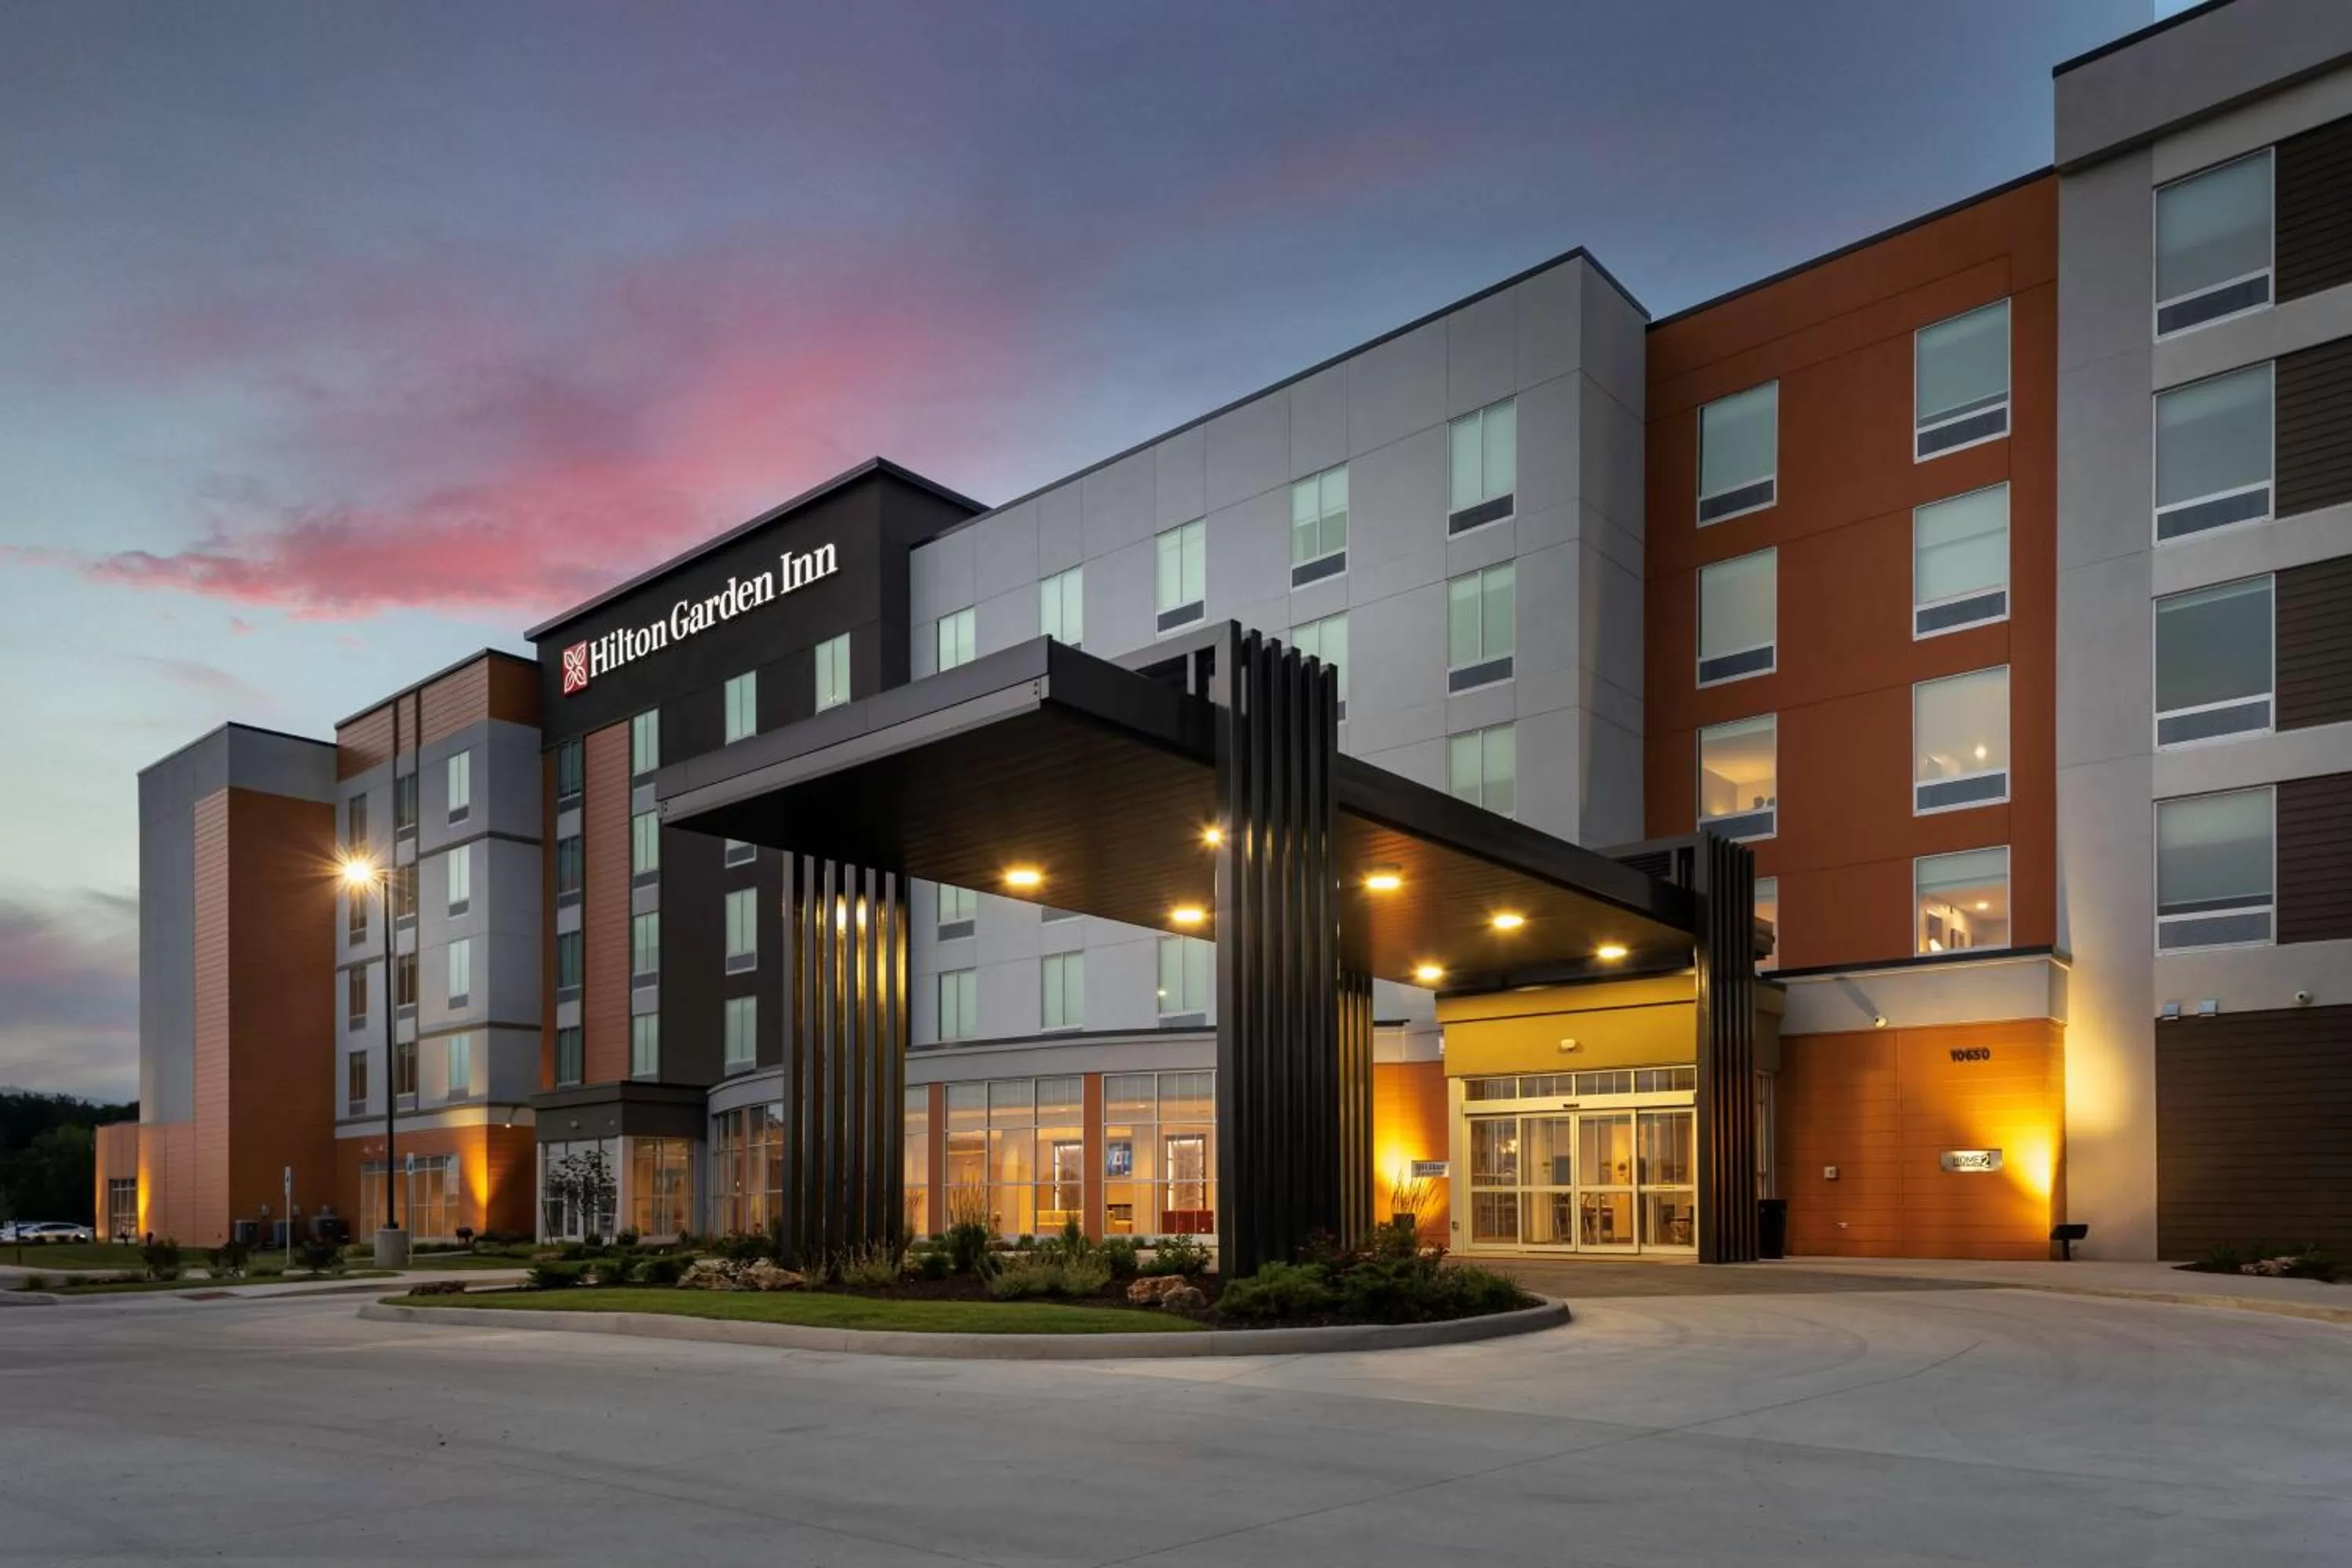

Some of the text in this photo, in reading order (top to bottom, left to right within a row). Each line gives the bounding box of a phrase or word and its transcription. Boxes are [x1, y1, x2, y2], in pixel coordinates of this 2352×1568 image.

[590, 543, 839, 678] Hilton Garden Inn
[1950, 1047, 1991, 1063] 10650
